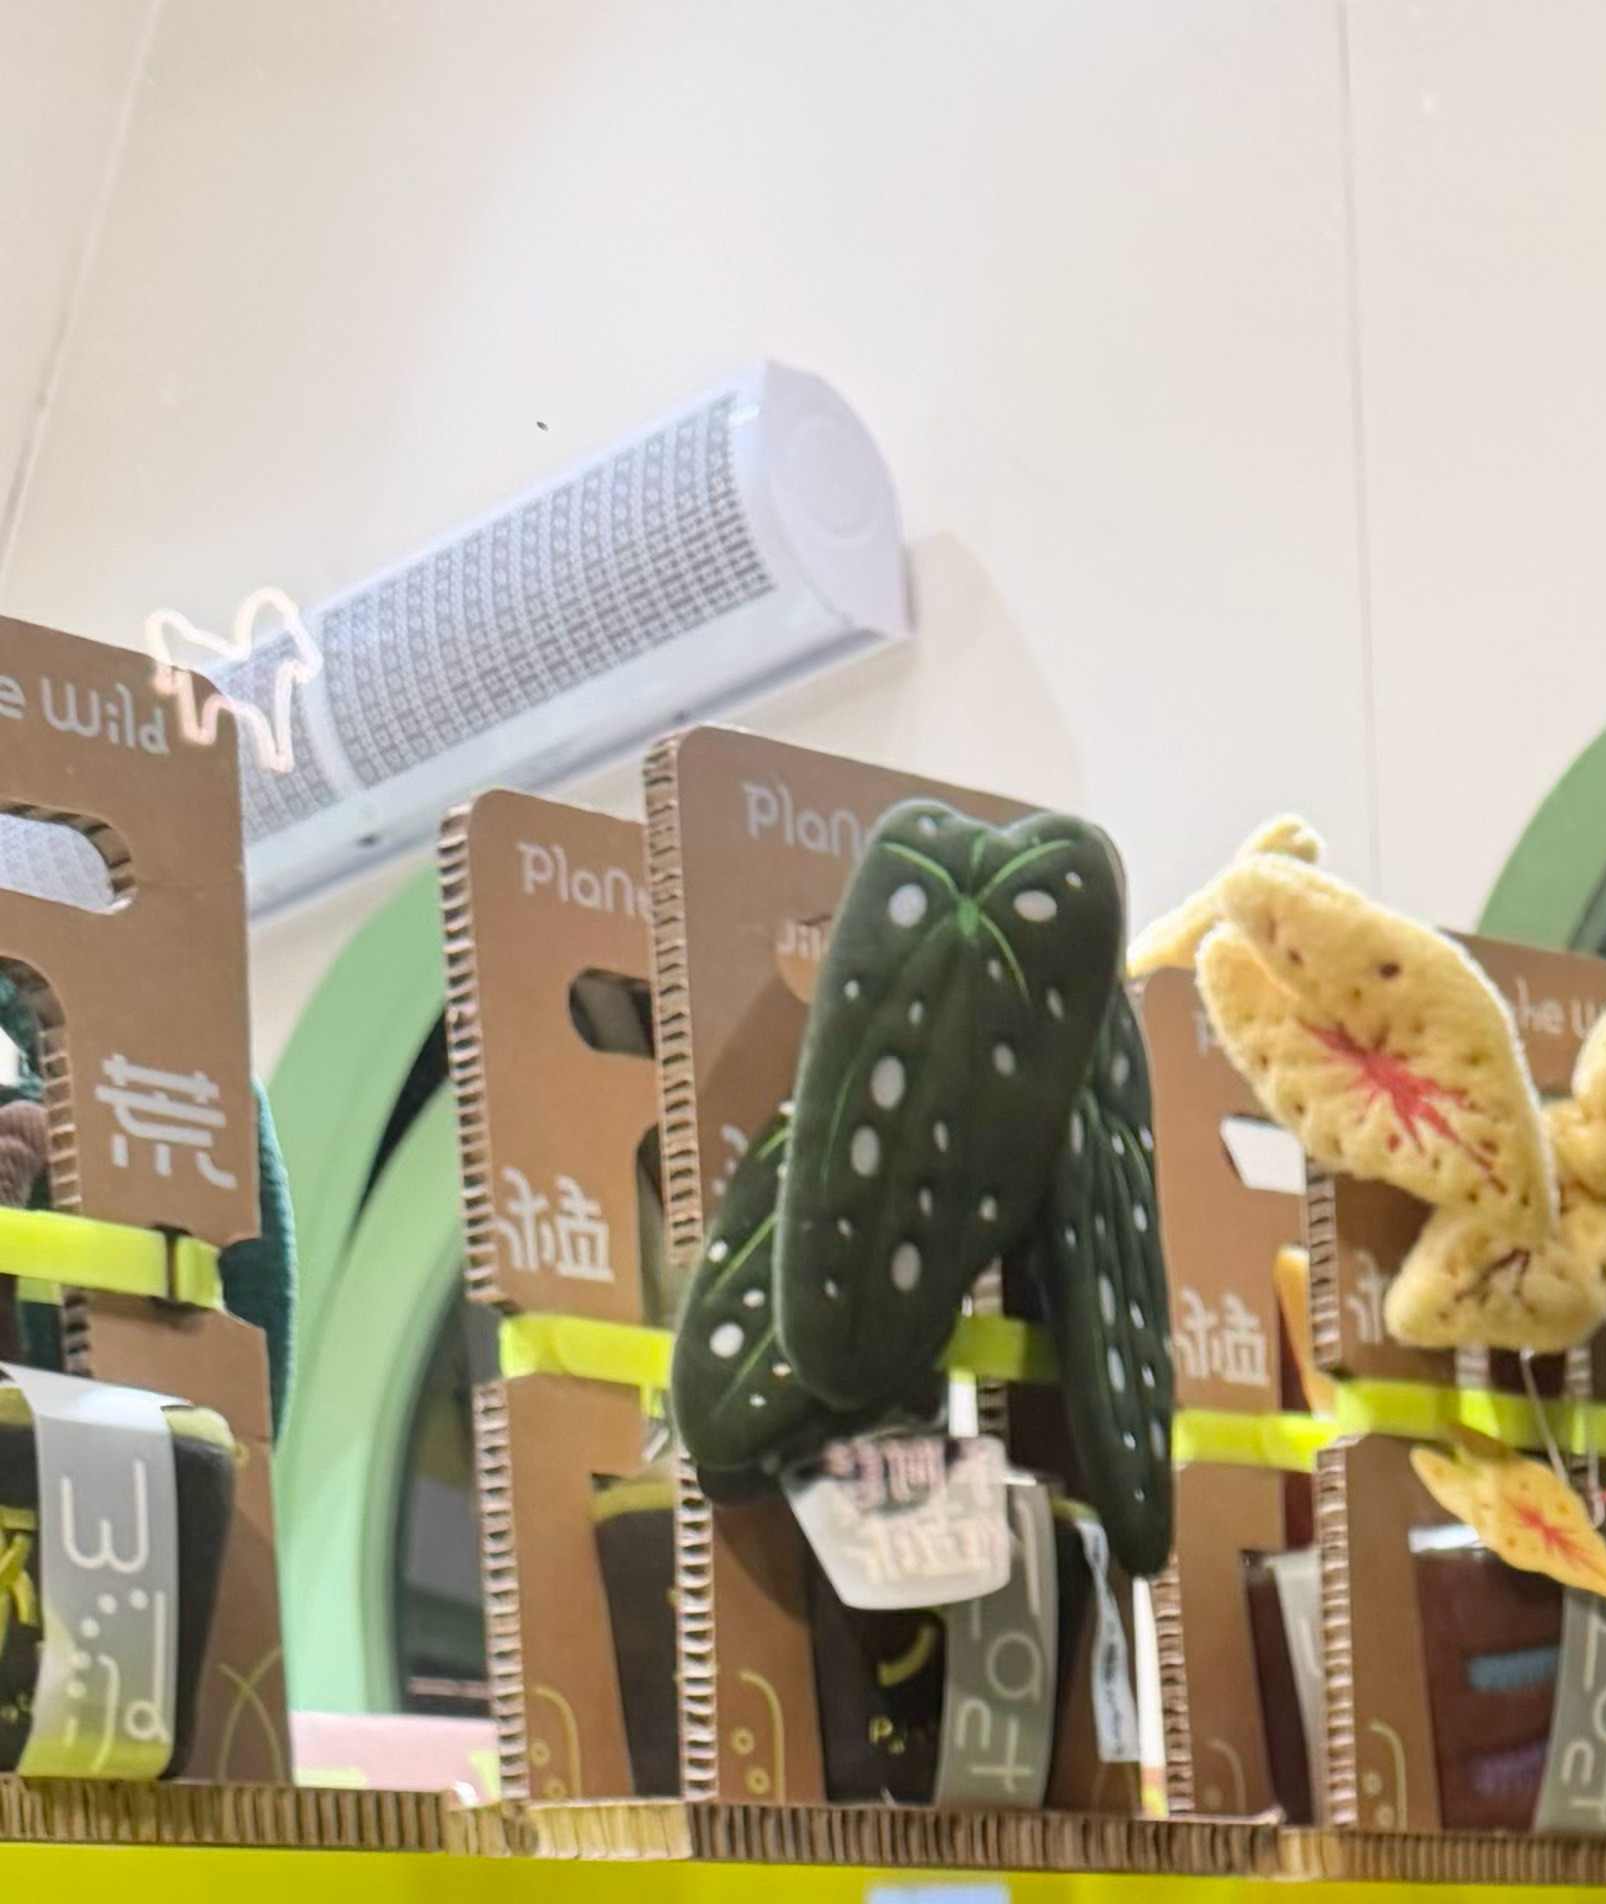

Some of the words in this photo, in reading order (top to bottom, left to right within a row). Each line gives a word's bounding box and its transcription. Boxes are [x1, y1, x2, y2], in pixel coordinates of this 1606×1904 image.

[41, 677, 170, 755] Wild
[740, 777, 862, 864] Plan
[95, 1053, 237, 1190] 荒
[497, 1164, 616, 1284] 植
